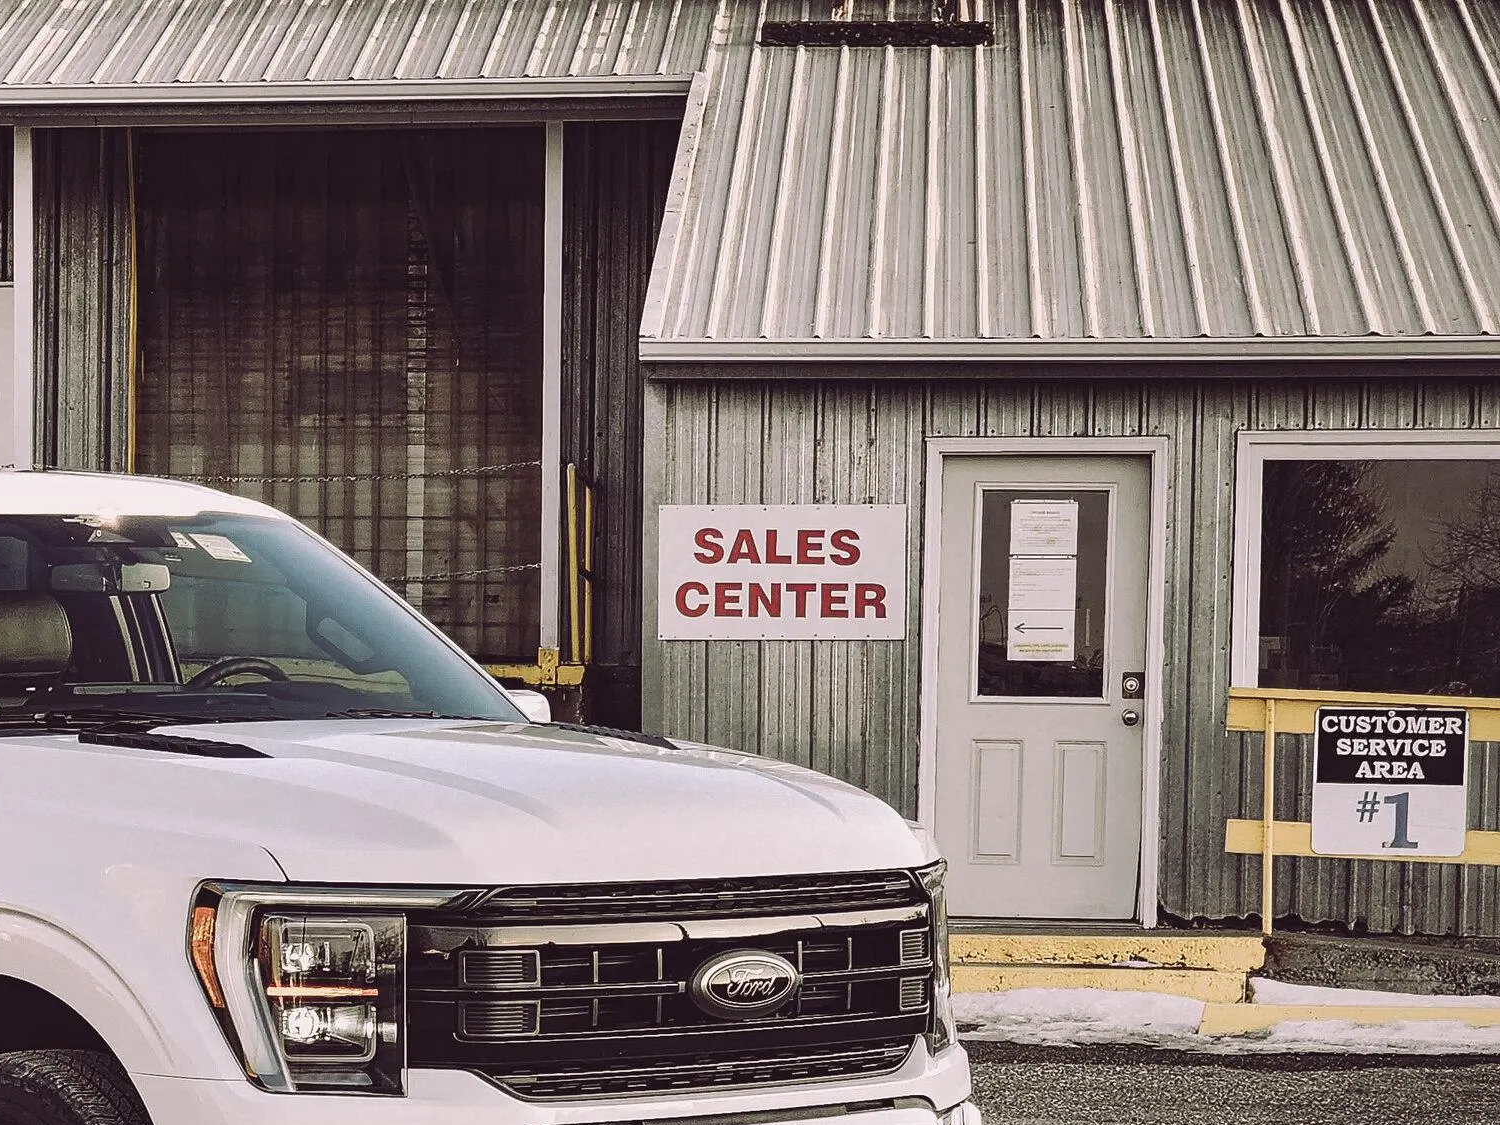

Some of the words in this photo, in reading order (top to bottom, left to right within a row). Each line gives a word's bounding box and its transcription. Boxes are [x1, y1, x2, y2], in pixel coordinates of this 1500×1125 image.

[693, 527, 861, 566] SALES
[675, 581, 888, 619] CENTER
[1321, 715, 1463, 735] CUSTOMER
[1336, 738, 1447, 757] SERVICE
[1355, 761, 1425, 779] AREA
[1356, 790, 1419, 849] #1
[727, 968, 777, 998] Ford
